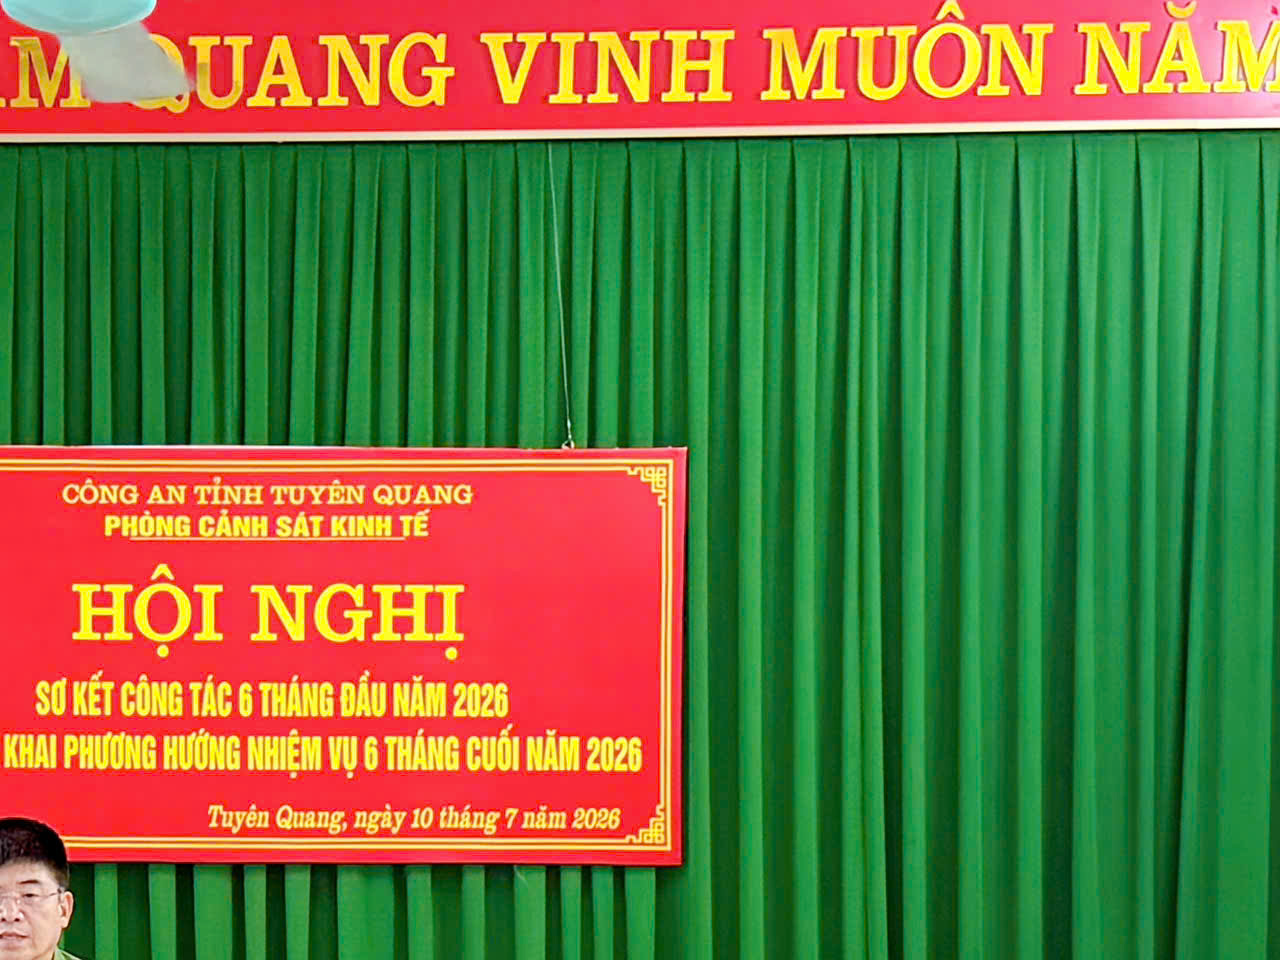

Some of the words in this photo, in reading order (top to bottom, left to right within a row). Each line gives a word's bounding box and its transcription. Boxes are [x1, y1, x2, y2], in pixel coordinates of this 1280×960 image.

[479, 28, 735, 105] VINH
[760, 0, 1055, 101] MUÔN
[1074, 0, 1280, 96] NĂM
[62, 478, 139, 505] CÔNG
[147, 484, 187, 505] AN
[193, 478, 264, 505] TỈNH
[271, 481, 366, 506] TUYÊN
[372, 484, 474, 506] QUANG
[104, 511, 192, 537] PHÒNG
[198, 508, 269, 537] CẢNH
[276, 510, 325, 537] SÁT
[330, 514, 393, 537] KINH
[400, 510, 431, 537] TẾ
[71, 563, 224, 659] HỘI
[250, 583, 465, 661] NGHỊ
[35, 677, 67, 716] SƠ
[72, 670, 115, 716] KẾT
[120, 674, 183, 717] CÔNG
[188, 674, 232, 717] TÁC
[238, 681, 253, 717] 6
[260, 674, 333, 717] THÁNG
[339, 669, 386, 717] ĐẦU
[392, 675, 447, 717] NĂM
[452, 682, 509, 717] 2026
[2, 733, 57, 768] KHAI
[63, 731, 156, 770] PHƯƠNG
[162, 727, 241, 770] HƯỚNG
[247, 728, 321, 778] NHIỆM
[327, 735, 358, 778] VỤ
[363, 736, 379, 770] 6
[384, 727, 459, 770] THÁNG
[465, 722, 520, 771] CUỐI
[526, 729, 580, 771] NĂM
[585, 736, 643, 772] 2026
[207, 804, 269, 833] Tuyên
[275, 804, 347, 834] Quang,
[352, 803, 407, 834] ngày
[410, 807, 434, 829] 10
[439, 804, 500, 834] tháng
[504, 808, 518, 829] 7
[522, 804, 566, 829] năm
[571, 807, 621, 829] 2026
